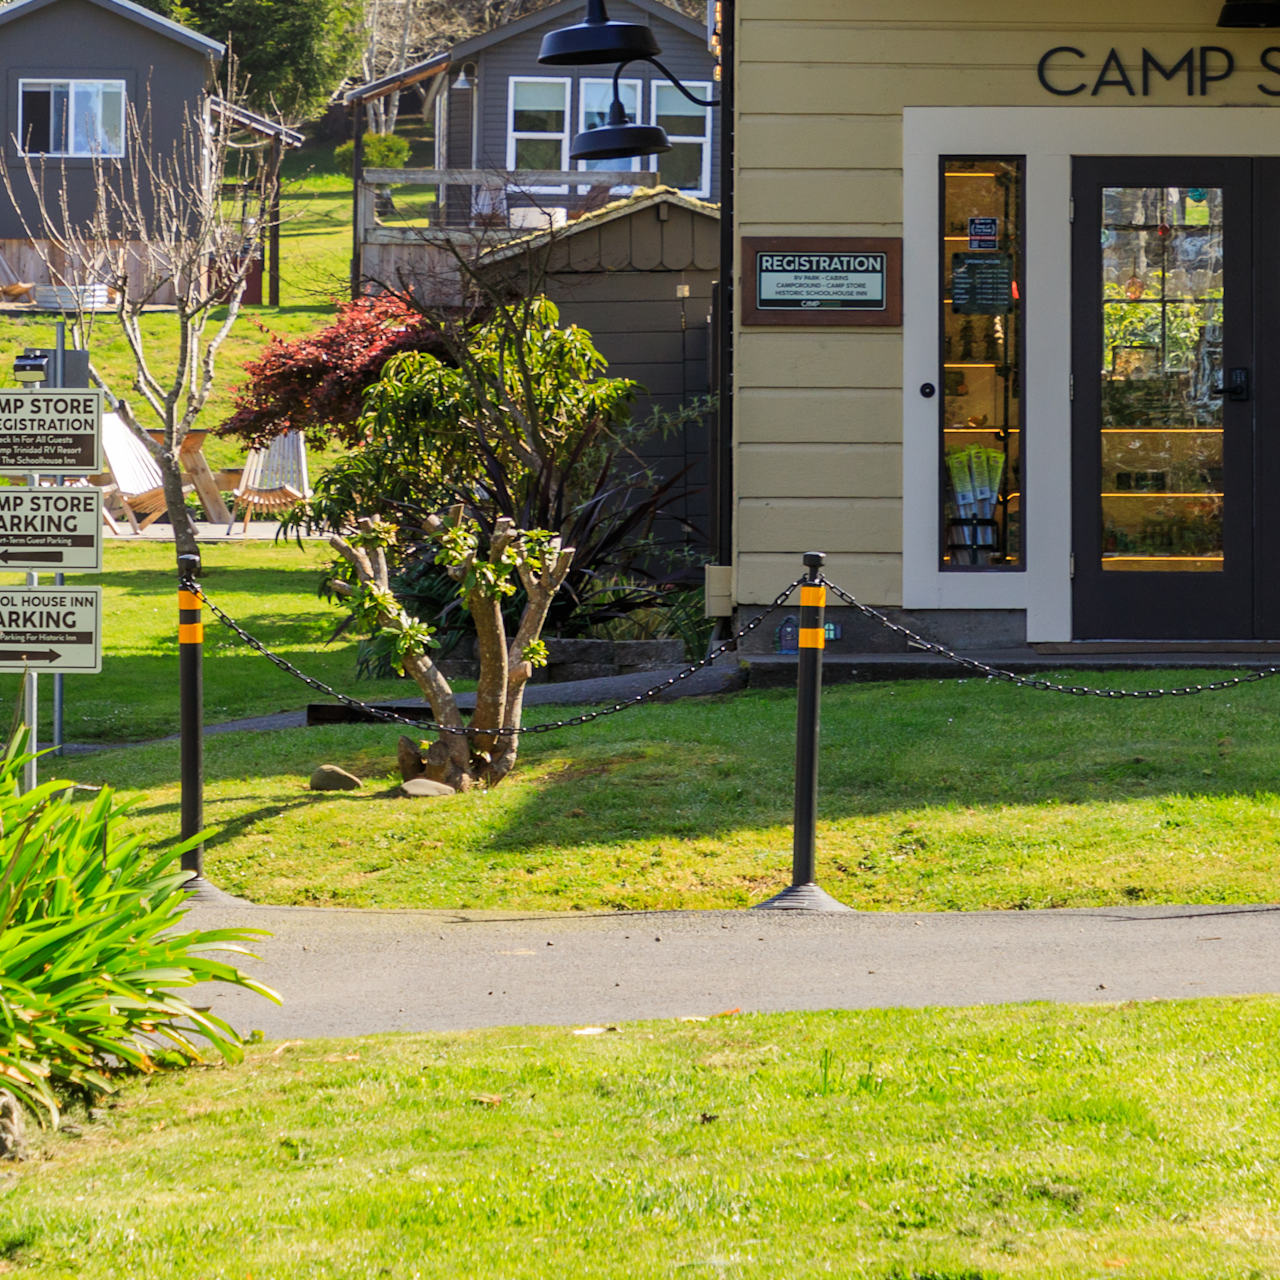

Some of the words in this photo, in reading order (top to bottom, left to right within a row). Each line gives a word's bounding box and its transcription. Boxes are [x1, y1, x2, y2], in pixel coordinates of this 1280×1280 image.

[1037, 46, 1235, 97] CAMP
[762, 256, 881, 271] REGISTRATION
[30, 398, 94, 414] STORE
[13, 435, 19, 444] In
[21, 435, 34, 444] For
[35, 435, 46, 444] All
[47, 435, 73, 444] Guests
[13, 445, 42, 454] Trinidad
[44, 446, 56, 454] RV
[57, 446, 81, 454] Resort
[1, 456, 15, 464] The
[17, 456, 63, 464] Schoolhouse
[64, 456, 76, 464] Inn
[30, 496, 94, 512] STORE
[26, 536, 46, 544] Guest
[47, 536, 72, 546] Parking
[22, 596, 67, 607] HOUSE
[71, 597, 94, 607] INN
[0, 633, 25, 642] Parking
[26, 633, 39, 641] For
[40, 633, 64, 641] Historic
